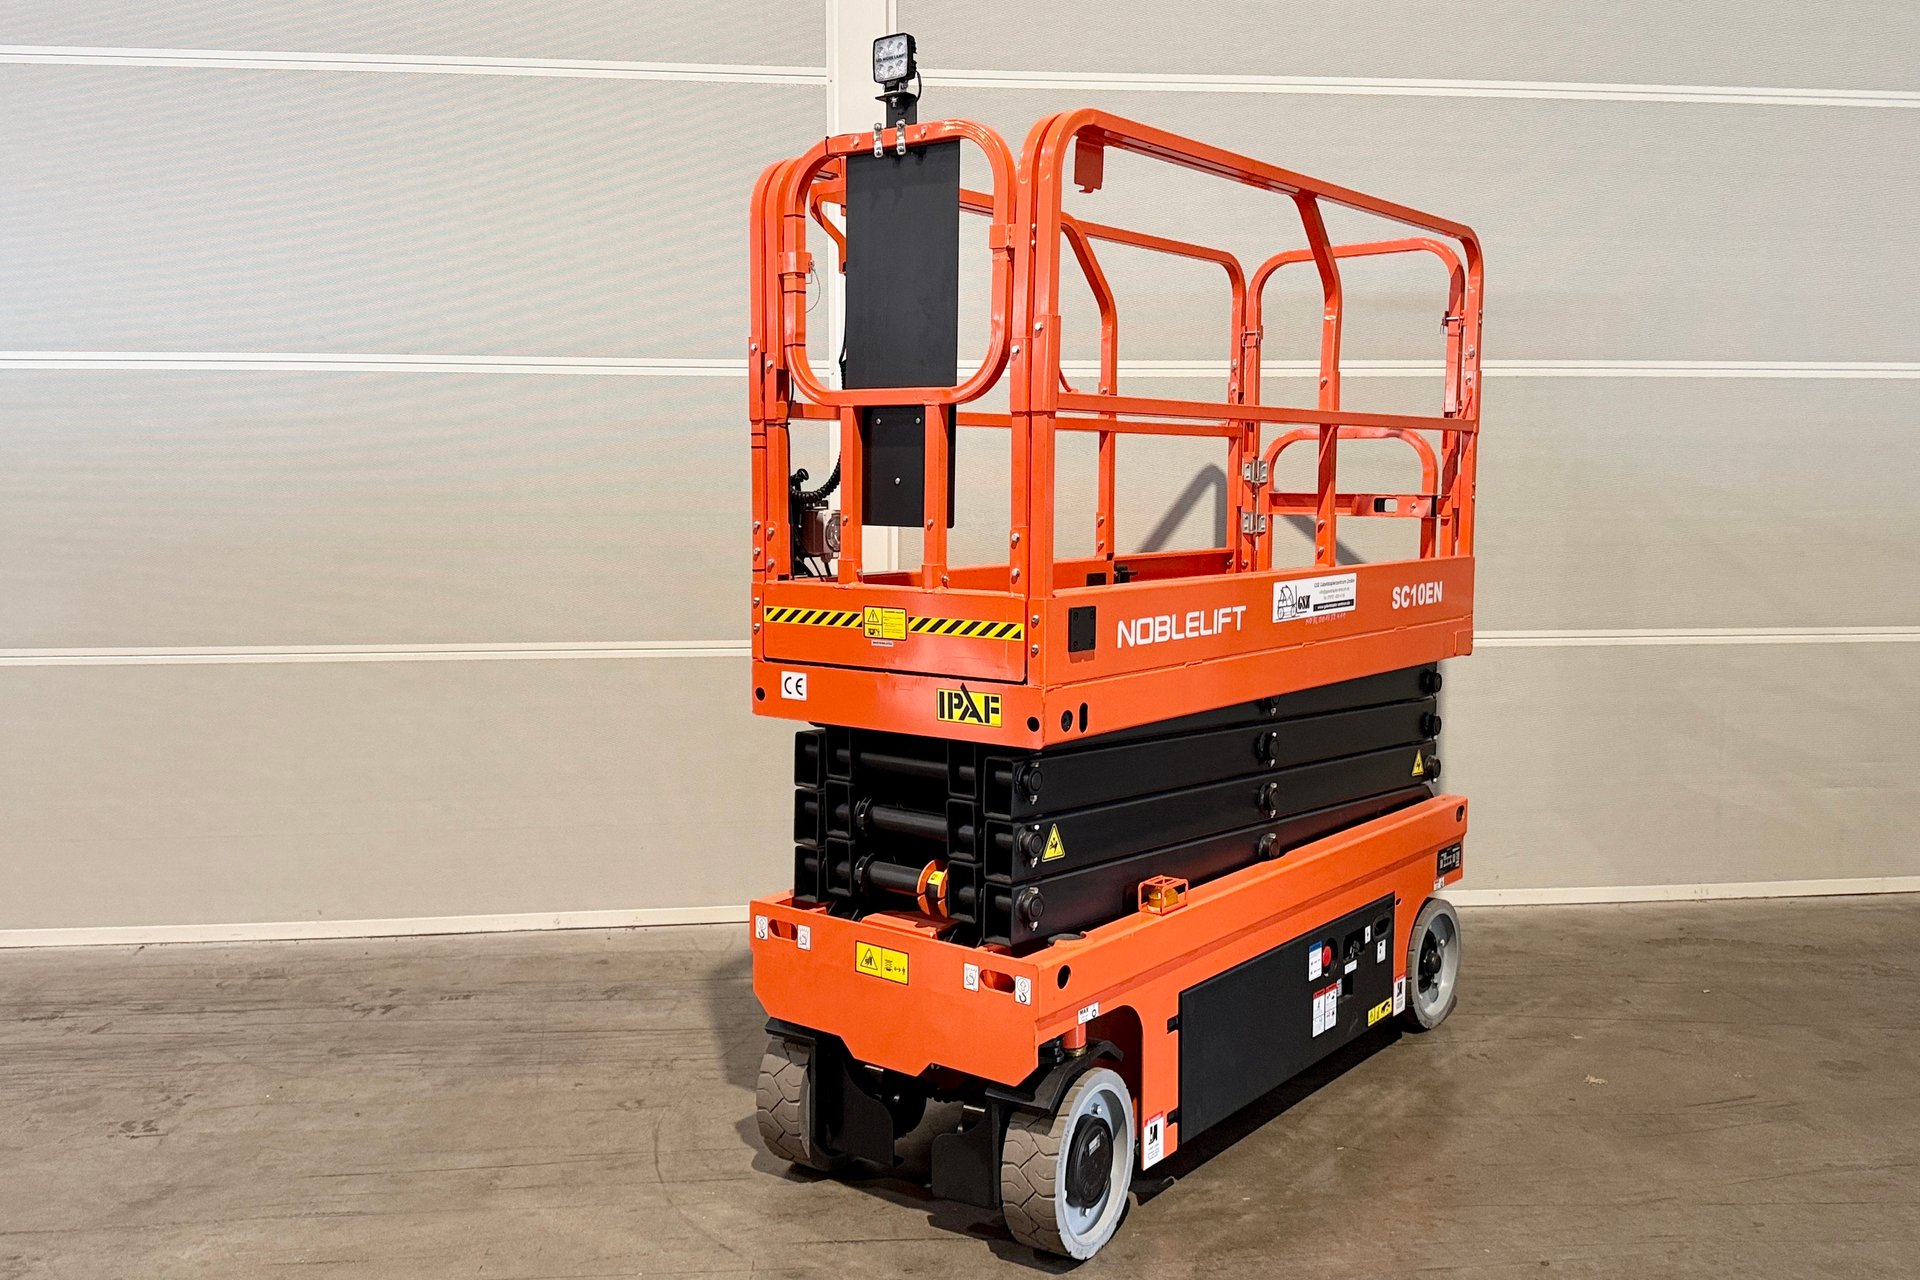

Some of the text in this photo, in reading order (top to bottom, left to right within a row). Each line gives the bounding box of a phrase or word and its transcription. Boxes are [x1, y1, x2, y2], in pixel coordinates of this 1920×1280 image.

[1391, 580, 1443, 610] SC10EN
[1117, 605, 1247, 649] NOBLELIFT
[784, 676, 803, 696] CE
[939, 682, 1000, 724] IPAF
